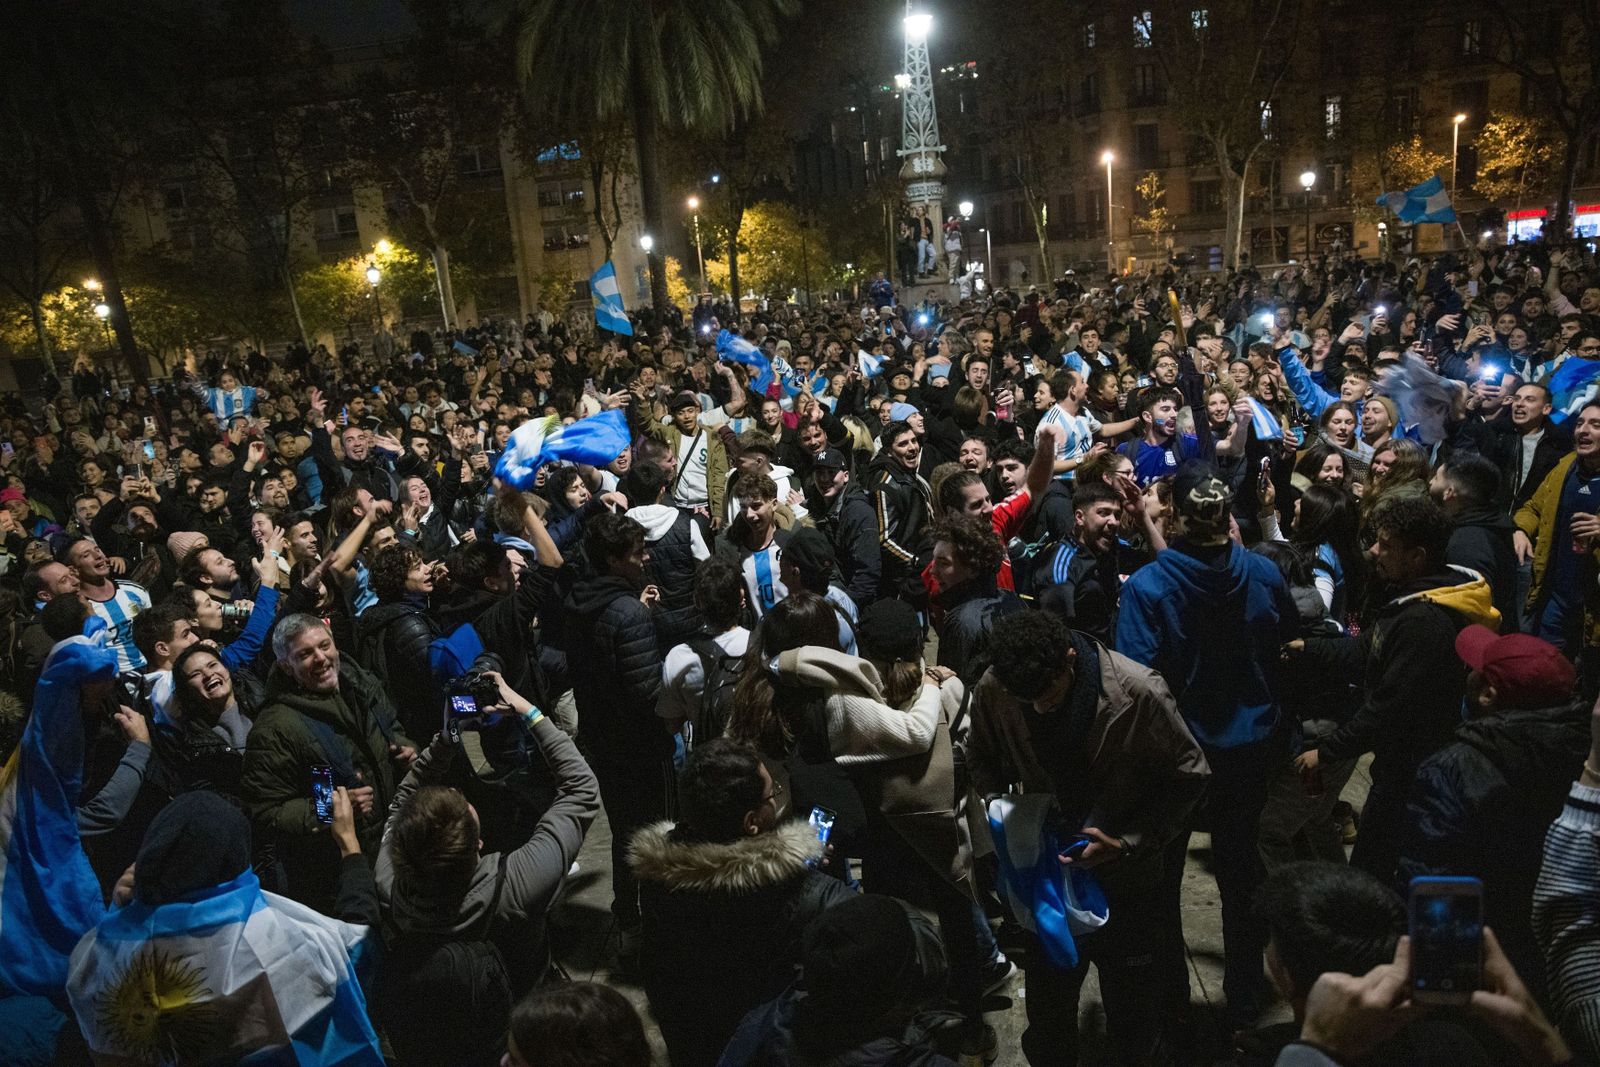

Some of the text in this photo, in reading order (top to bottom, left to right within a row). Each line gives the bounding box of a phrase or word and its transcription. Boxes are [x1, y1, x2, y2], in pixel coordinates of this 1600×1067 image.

[699, 448, 708, 462] S
[817, 451, 827, 461] NY
[758, 584, 775, 604] 10
